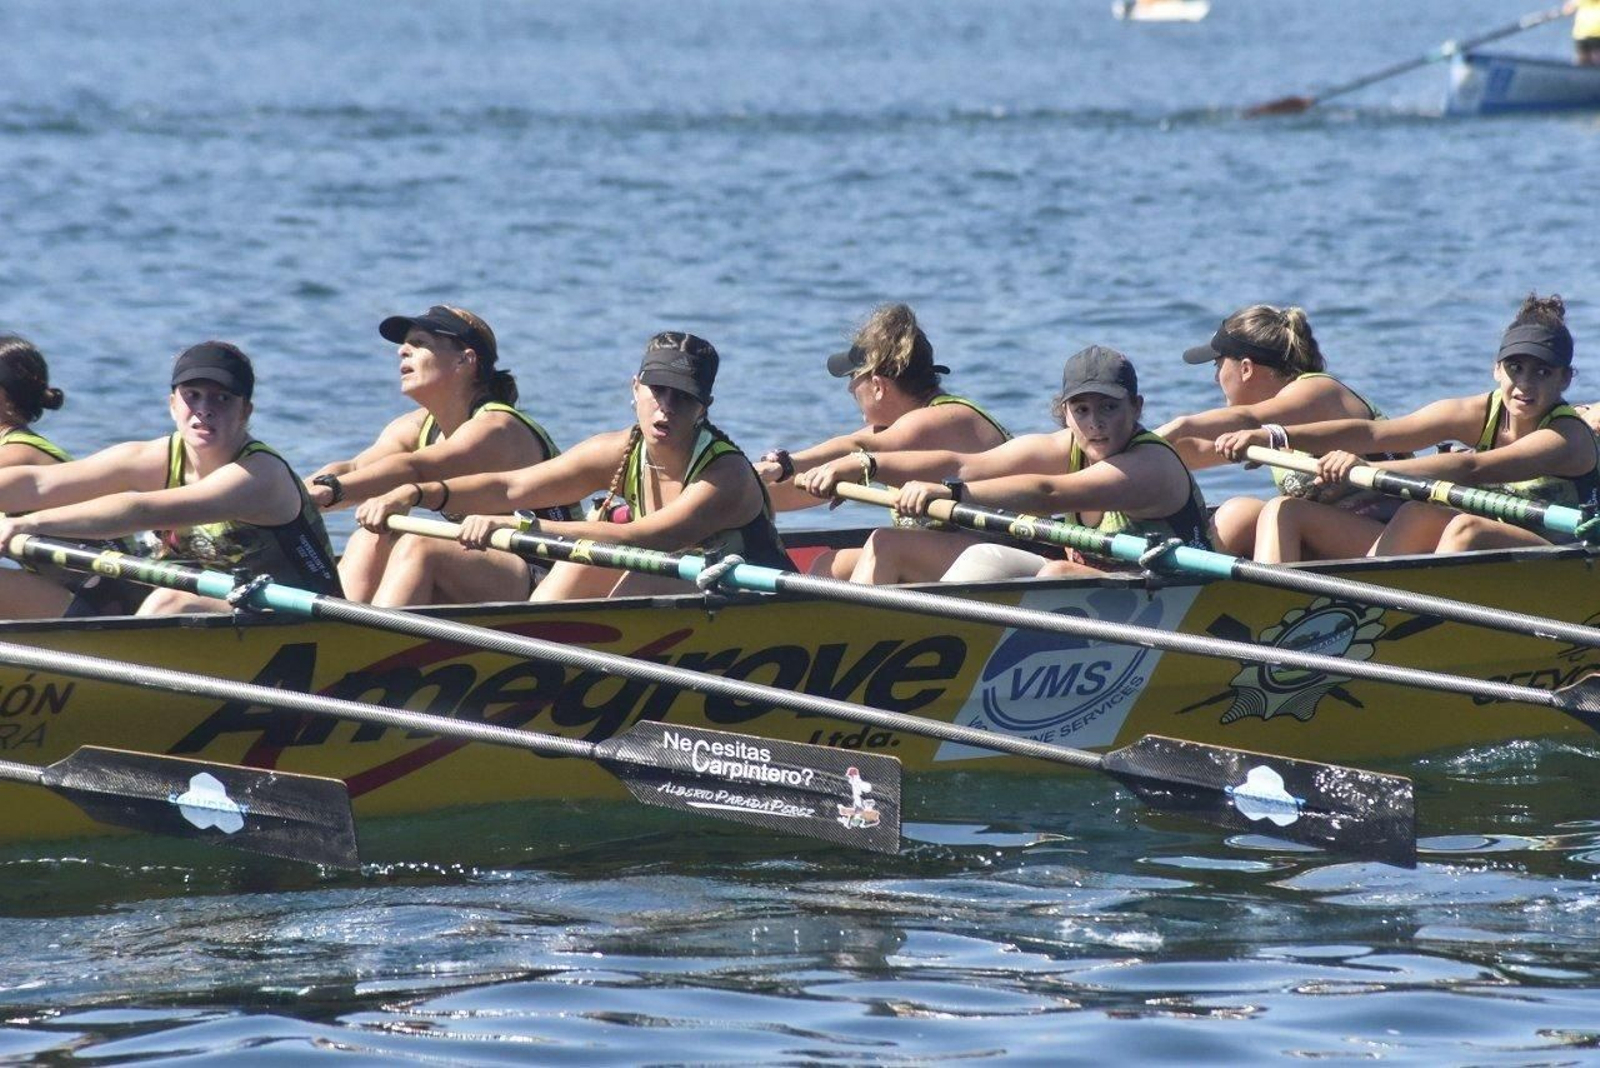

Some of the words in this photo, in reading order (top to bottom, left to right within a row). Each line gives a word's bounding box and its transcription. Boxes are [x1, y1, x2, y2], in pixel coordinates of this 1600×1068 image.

[1010, 660, 1112, 701] VMS
[1059, 675, 1145, 738] SERVICES
[692, 740, 815, 786] Carpintero?
